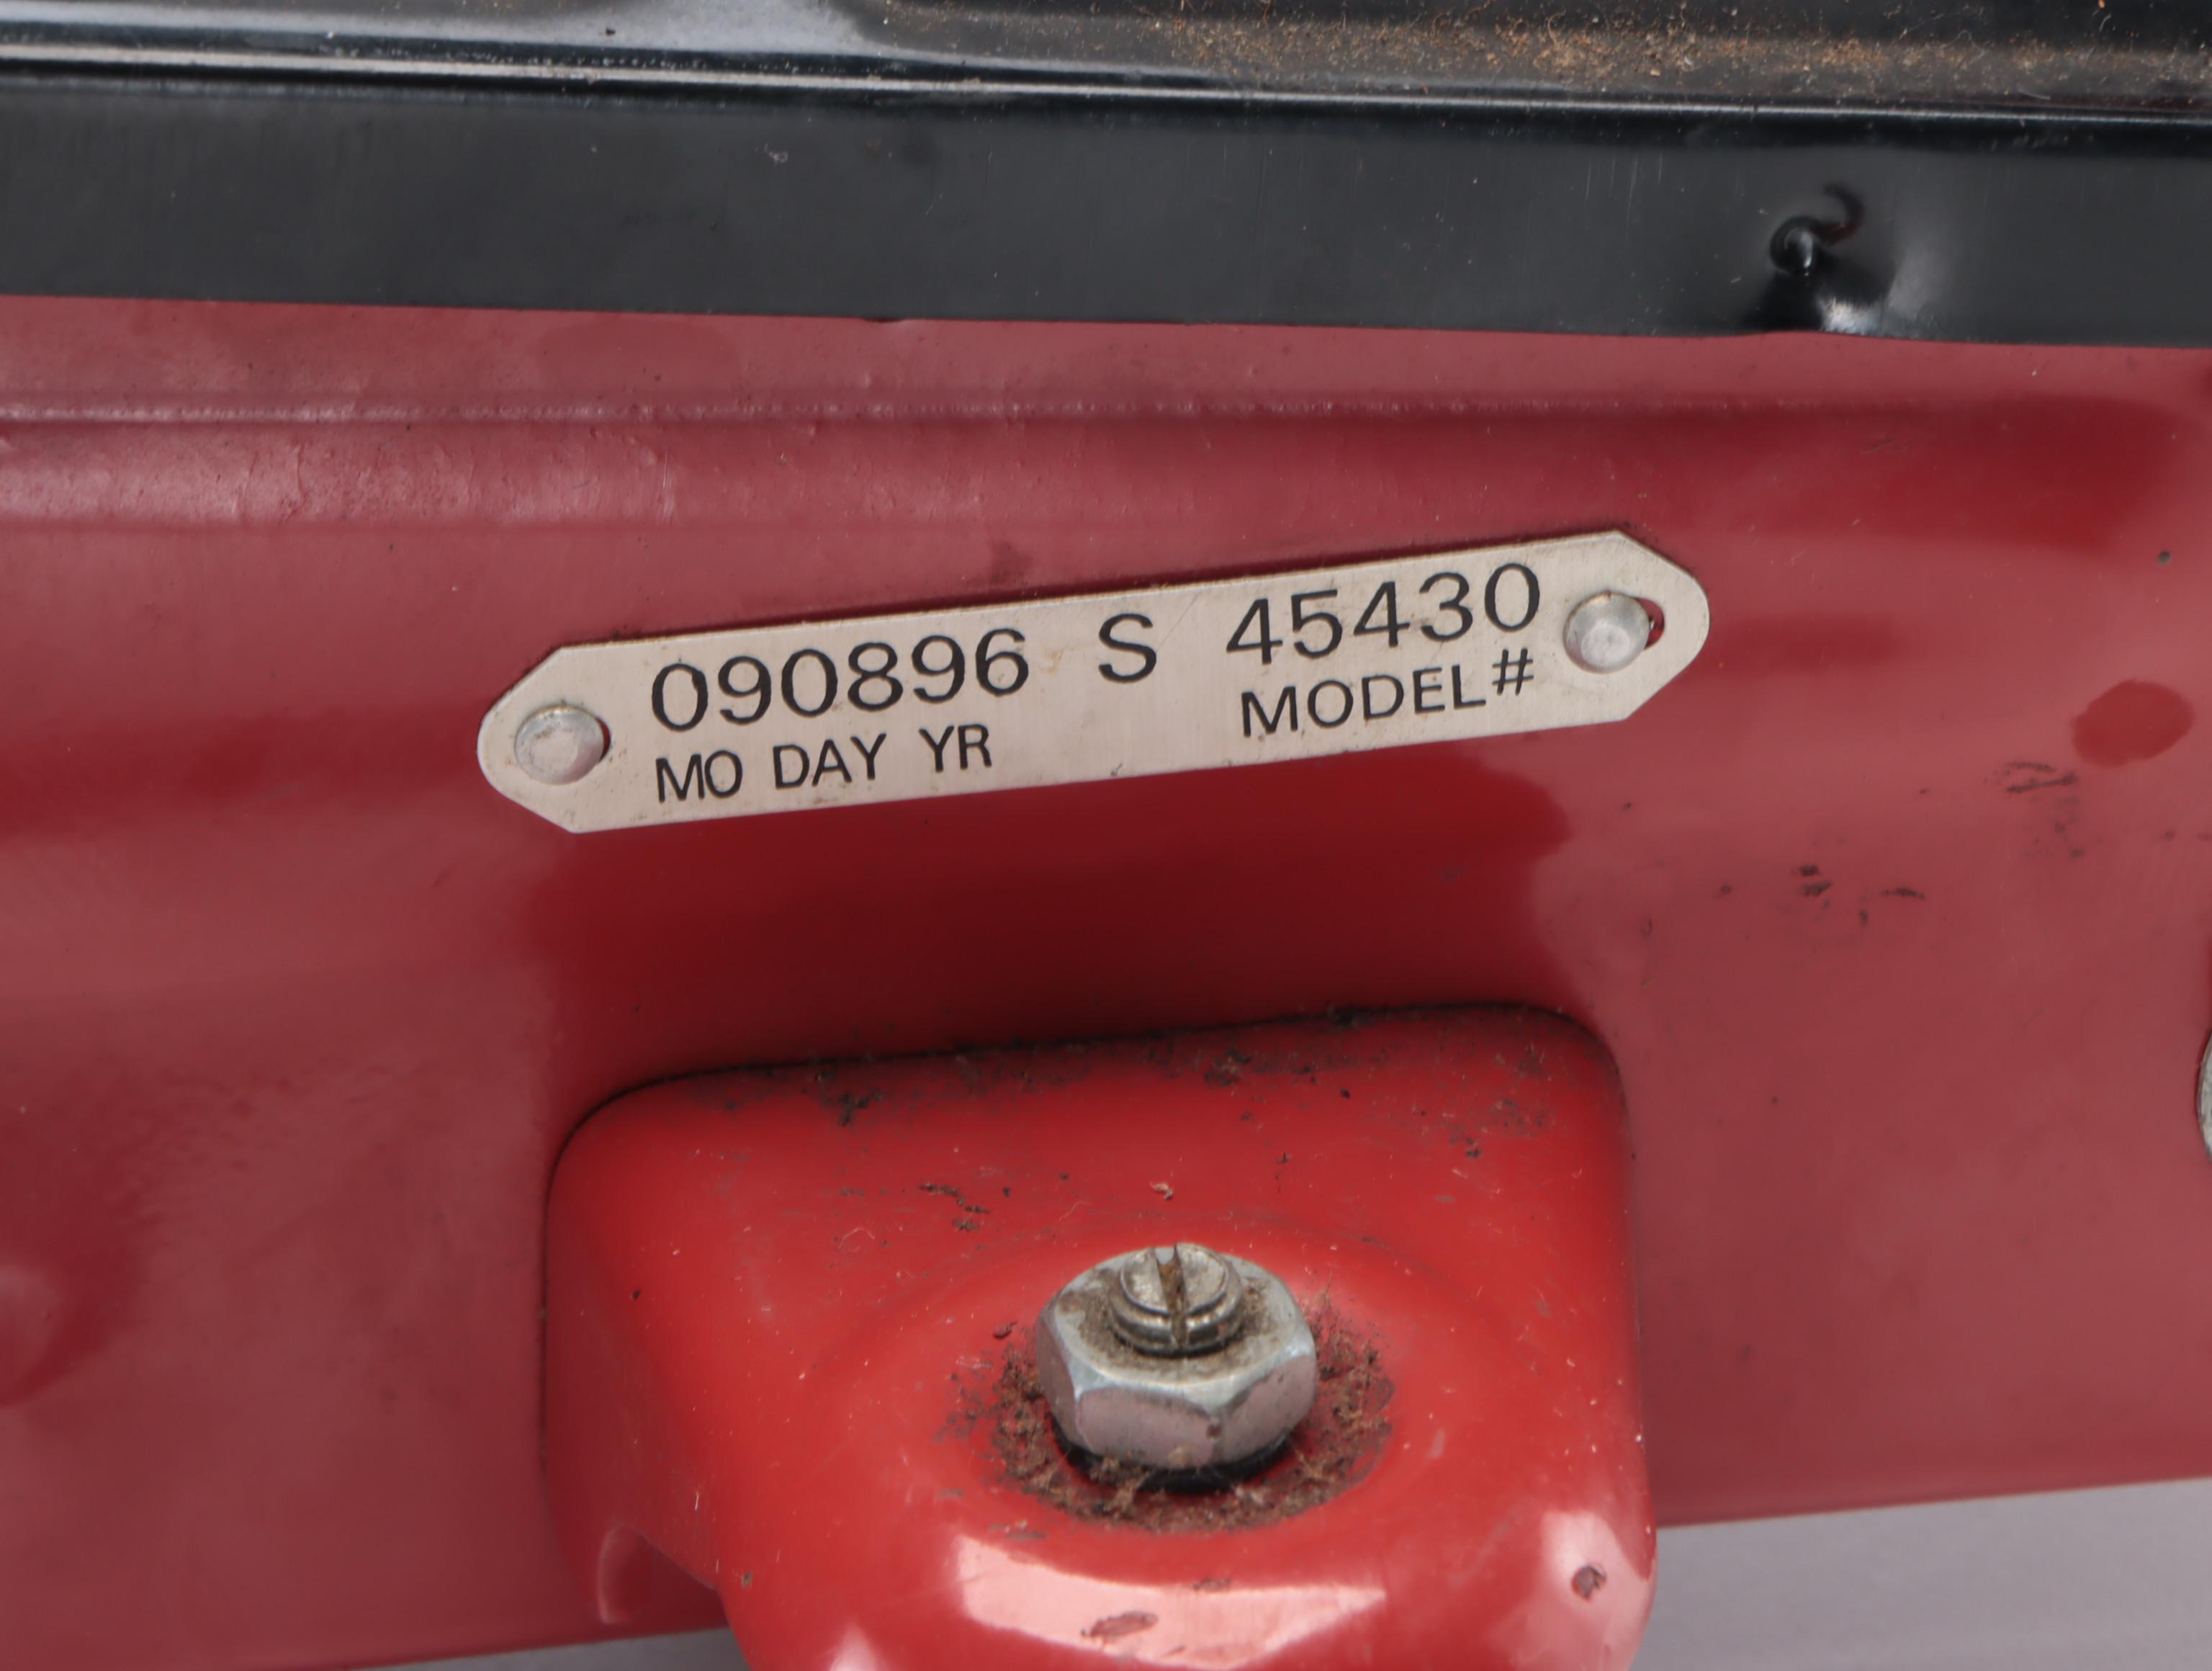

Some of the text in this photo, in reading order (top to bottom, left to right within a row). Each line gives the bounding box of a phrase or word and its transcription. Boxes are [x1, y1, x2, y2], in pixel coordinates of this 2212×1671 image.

[651, 563, 1540, 732] 090896 S 45430
[655, 648, 1534, 803] MO DAY YR MODEL#
